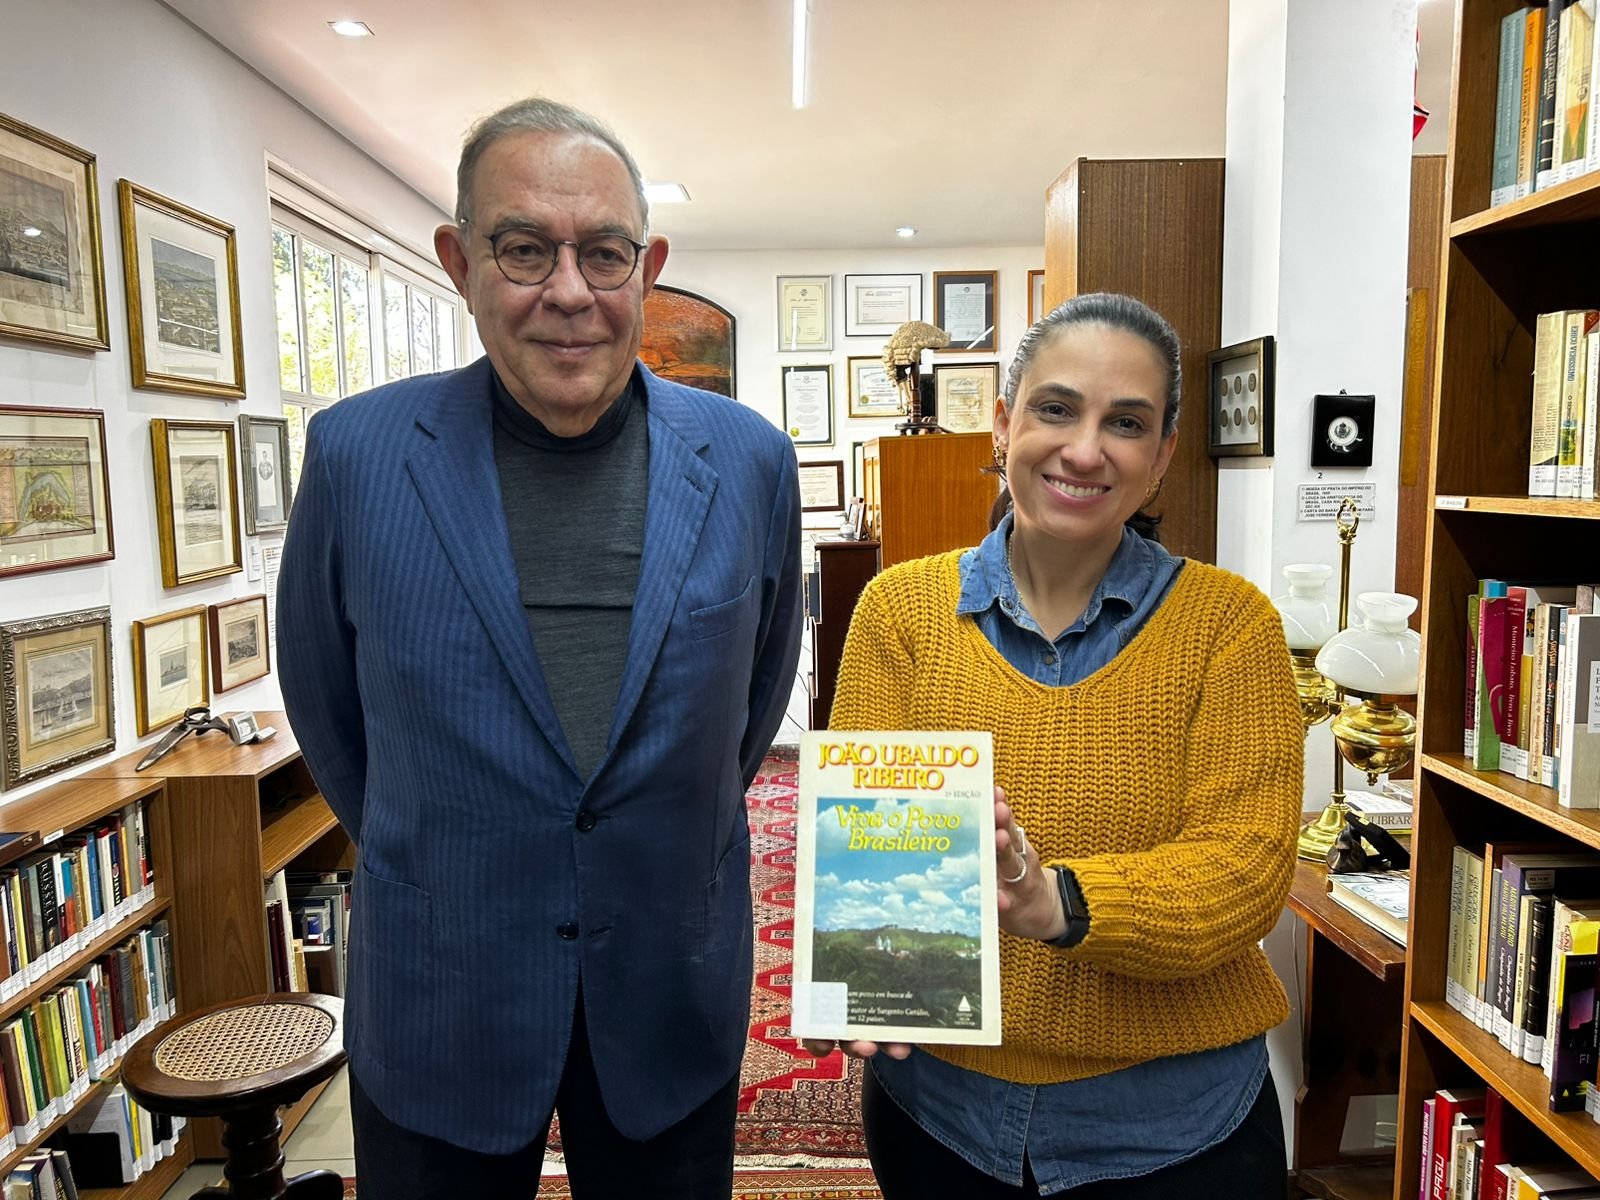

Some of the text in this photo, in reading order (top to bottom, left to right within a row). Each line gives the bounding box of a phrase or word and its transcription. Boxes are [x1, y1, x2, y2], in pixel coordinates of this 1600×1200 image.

[1568, 326, 1578, 382] ERICO VERISSIMO
[1510, 625, 1519, 660] Monteiro
[1548, 640, 1558, 666] Suassuna
[818, 742, 979, 769] JOÃO UBALDO
[853, 766, 945, 790] RIBEIRO
[954, 790, 982, 799] EDIÇÃO
[836, 804, 961, 830] Viva o Povo
[1371, 815, 1412, 825] LIBRAR
[847, 827, 951, 852] Brasileiro
[41, 863, 54, 925] RUSSELL
[1500, 879, 1510, 939] MÁRIO PALMÉRIO
[1508, 886, 1518, 948] MÁRIO PALMÉRIO
[886, 990, 904, 999] busca
[905, 990, 914, 999] de
[876, 1006, 904, 1016] Sargento
[905, 1008, 930, 1017] Getúlio,
[1433, 1153, 1444, 1200] PAGU
